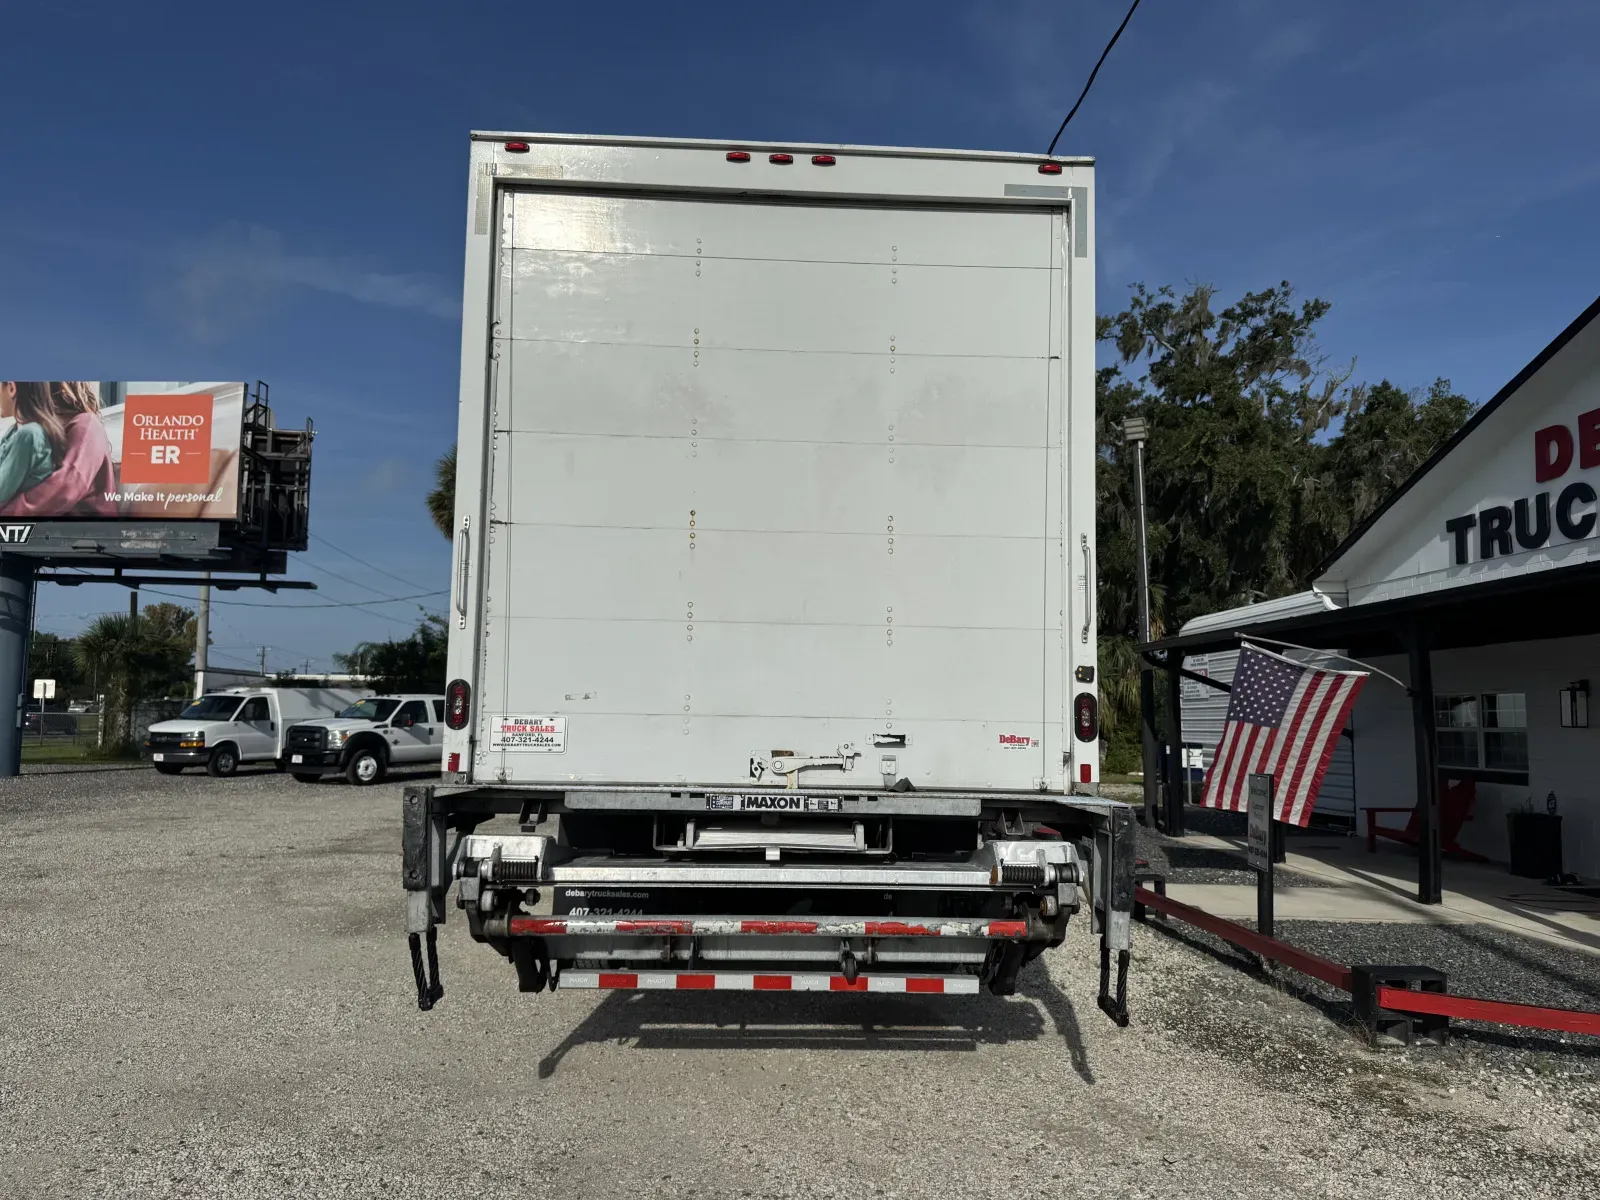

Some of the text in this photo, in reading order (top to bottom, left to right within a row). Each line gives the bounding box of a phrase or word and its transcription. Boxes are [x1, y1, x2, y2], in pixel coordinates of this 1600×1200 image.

[133, 413, 204, 428] ORLANDO
[140, 428, 196, 440] HEALTH
[150, 445, 181, 464] ER
[104, 488, 222, 510] We Make It personal
[1446, 482, 1598, 565] TRUC
[999, 734, 1030, 746] DeBary
[745, 796, 801, 809] MAXON
[565, 889, 649, 899] debarytrucksales.com
